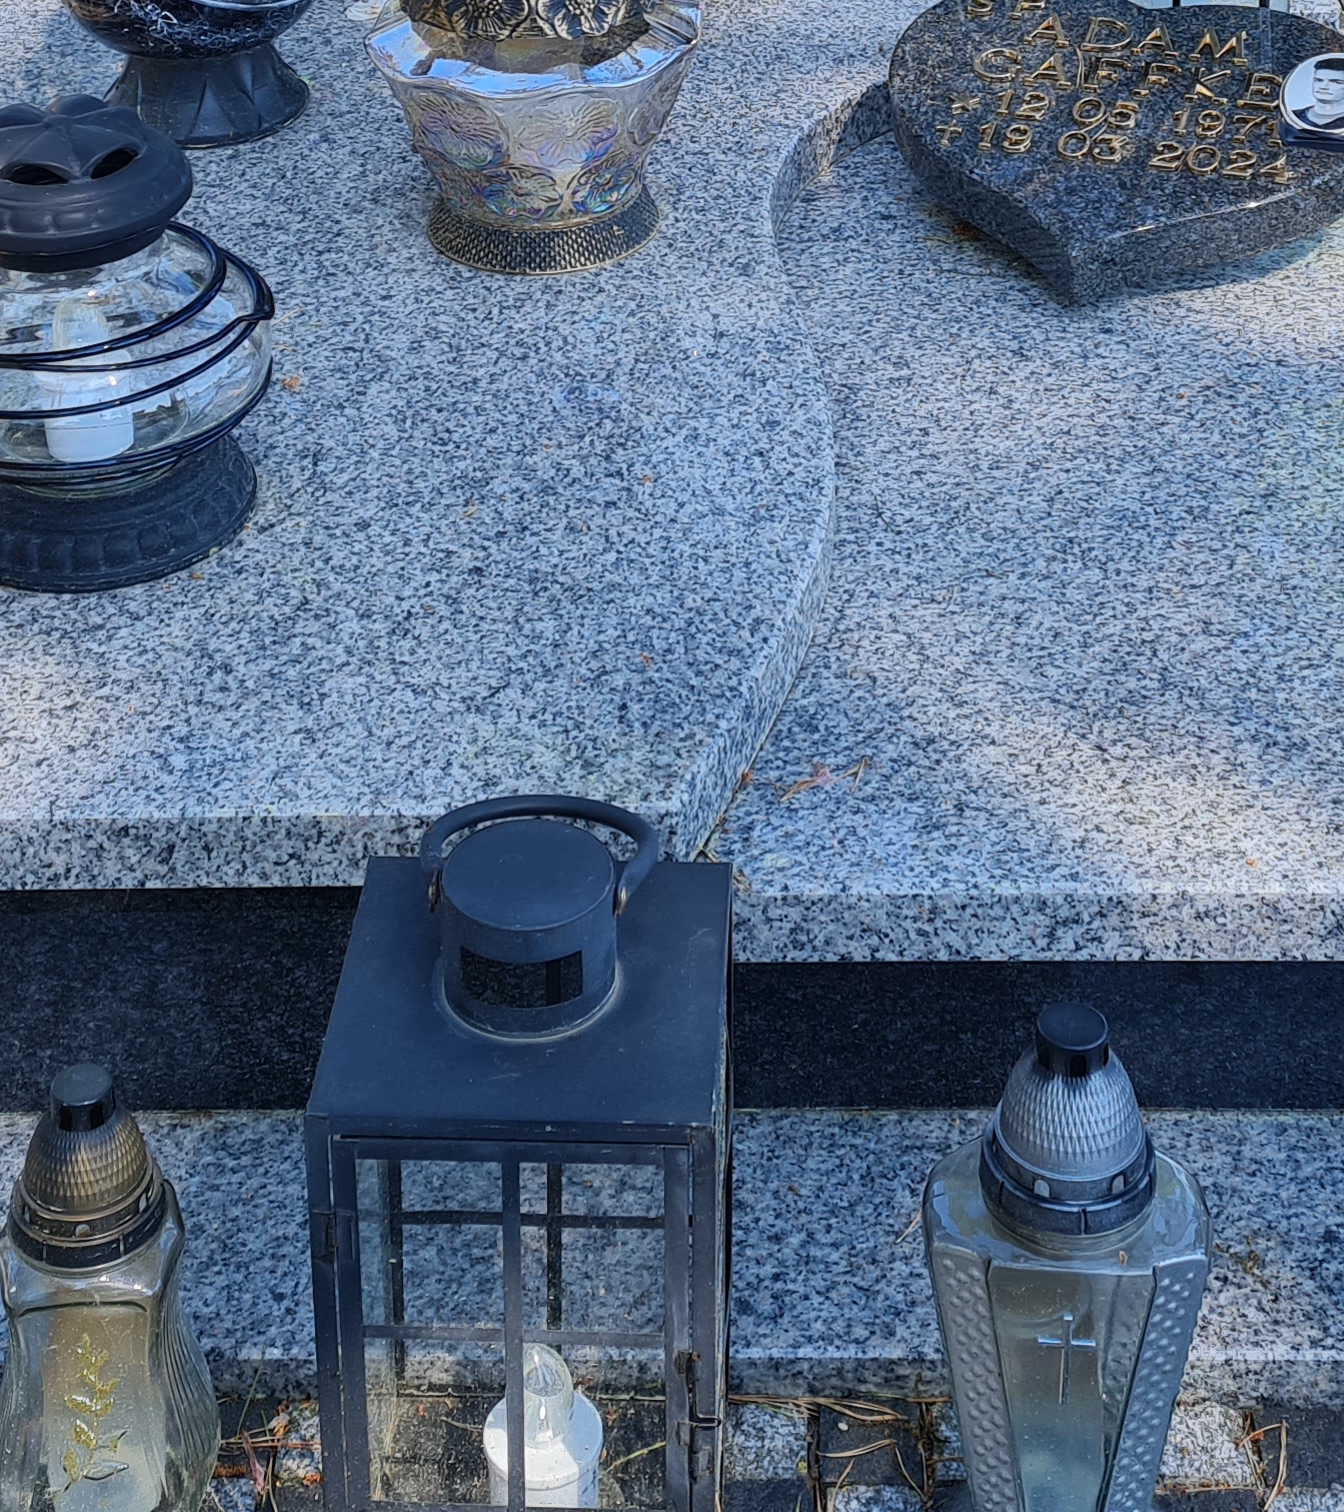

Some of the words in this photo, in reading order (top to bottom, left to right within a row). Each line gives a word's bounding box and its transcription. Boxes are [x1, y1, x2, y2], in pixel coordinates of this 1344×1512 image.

[1022, 14, 1250, 67] ADAM
[972, 47, 1285, 112] GAFFKE
[995, 88, 1051, 122] 12
[1071, 96, 1141, 131] 05
[1173, 107, 1283, 149] 1971
[977, 121, 1034, 153] 19
[1057, 129, 1130, 164] 03
[1147, 140, 1298, 185] 2024
